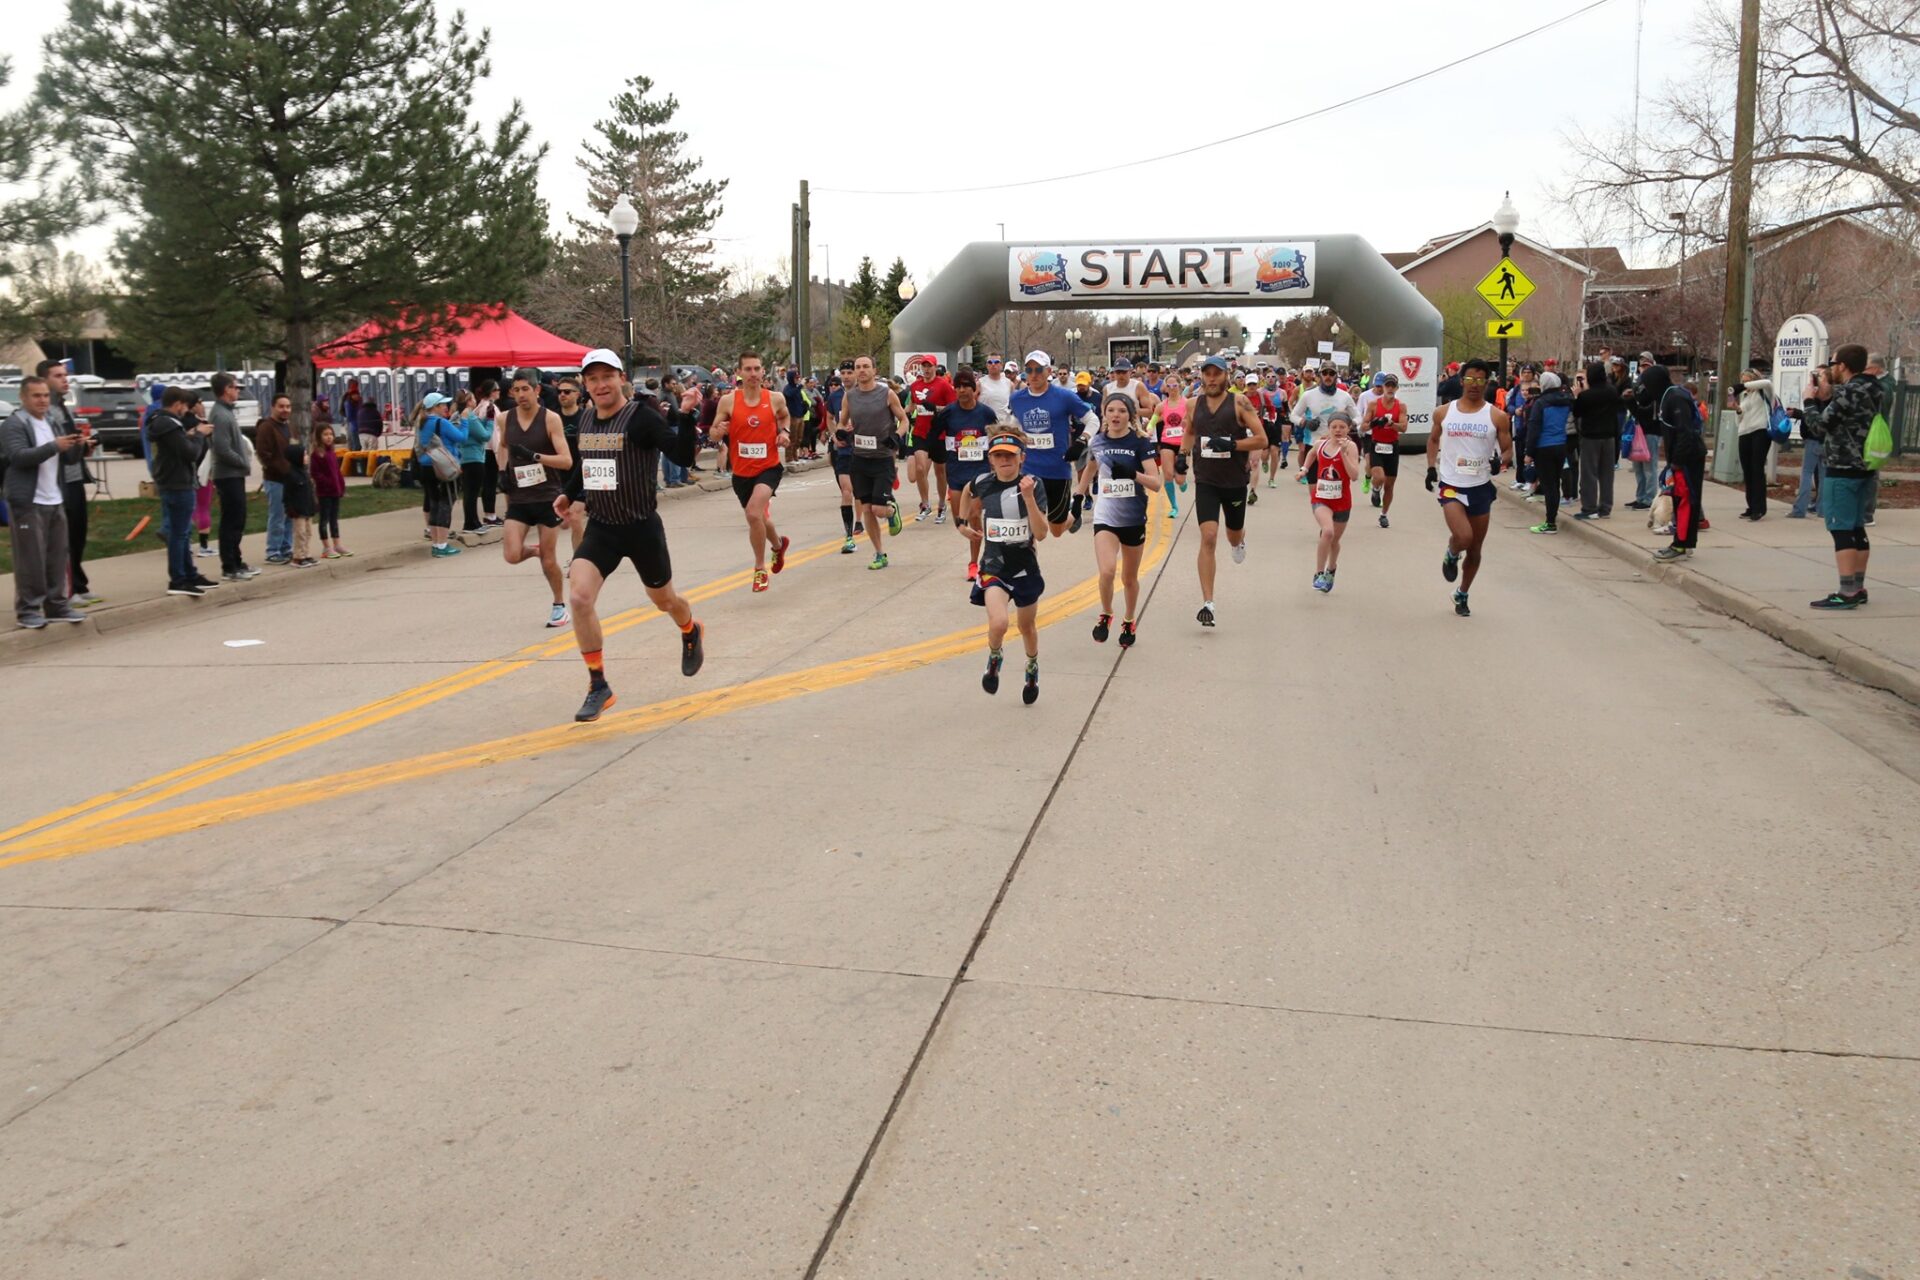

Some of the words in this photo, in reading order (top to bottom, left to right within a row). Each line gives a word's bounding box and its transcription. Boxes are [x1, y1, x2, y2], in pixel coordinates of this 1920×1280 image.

[1035, 264, 1053, 272] 2019
[1080, 248, 1243, 287] START
[1273, 261, 1292, 269] 2019
[1779, 338, 1813, 347] ARAPAHOE
[1781, 358, 1808, 367] COLLEGE
[1447, 422, 1489, 433] COLORADO
[1036, 437, 1052, 446] 975
[750, 447, 764, 455] 327
[970, 450, 982, 458] 156
[526, 467, 542, 477] 674
[591, 466, 616, 478] 2018
[1113, 483, 1134, 493] 2047
[1001, 525, 1028, 537] 2017
